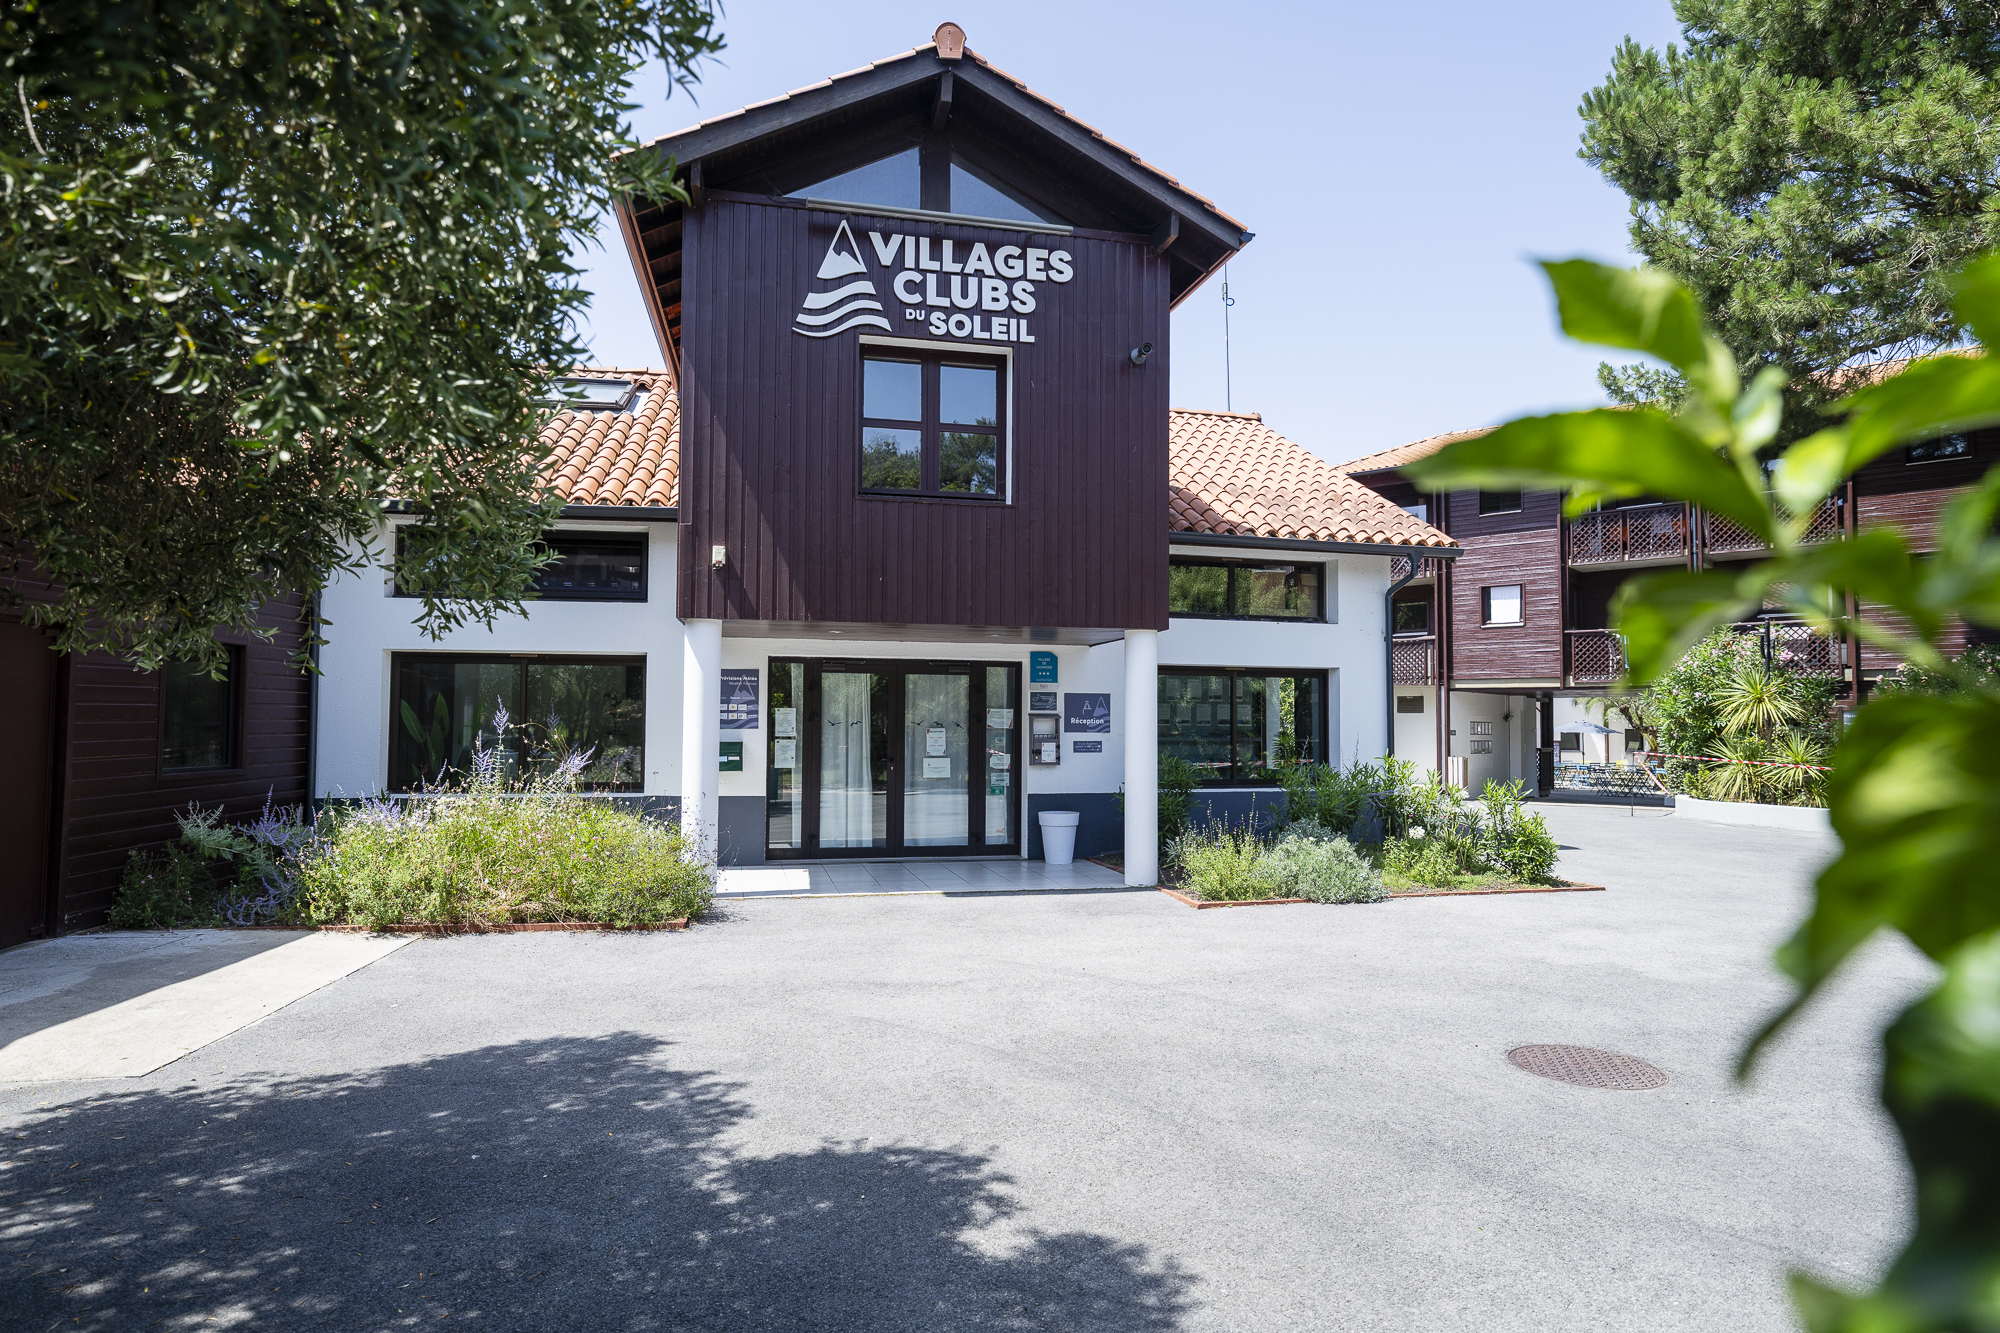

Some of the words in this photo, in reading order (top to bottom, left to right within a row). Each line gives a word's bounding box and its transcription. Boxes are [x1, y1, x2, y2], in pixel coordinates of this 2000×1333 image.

[868, 231, 1074, 283] VILLAGES
[893, 270, 1036, 314] CLUBS
[905, 308, 925, 321] DU
[929, 311, 1035, 343] SOLEIL
[1070, 716, 1105, 726] Réception
